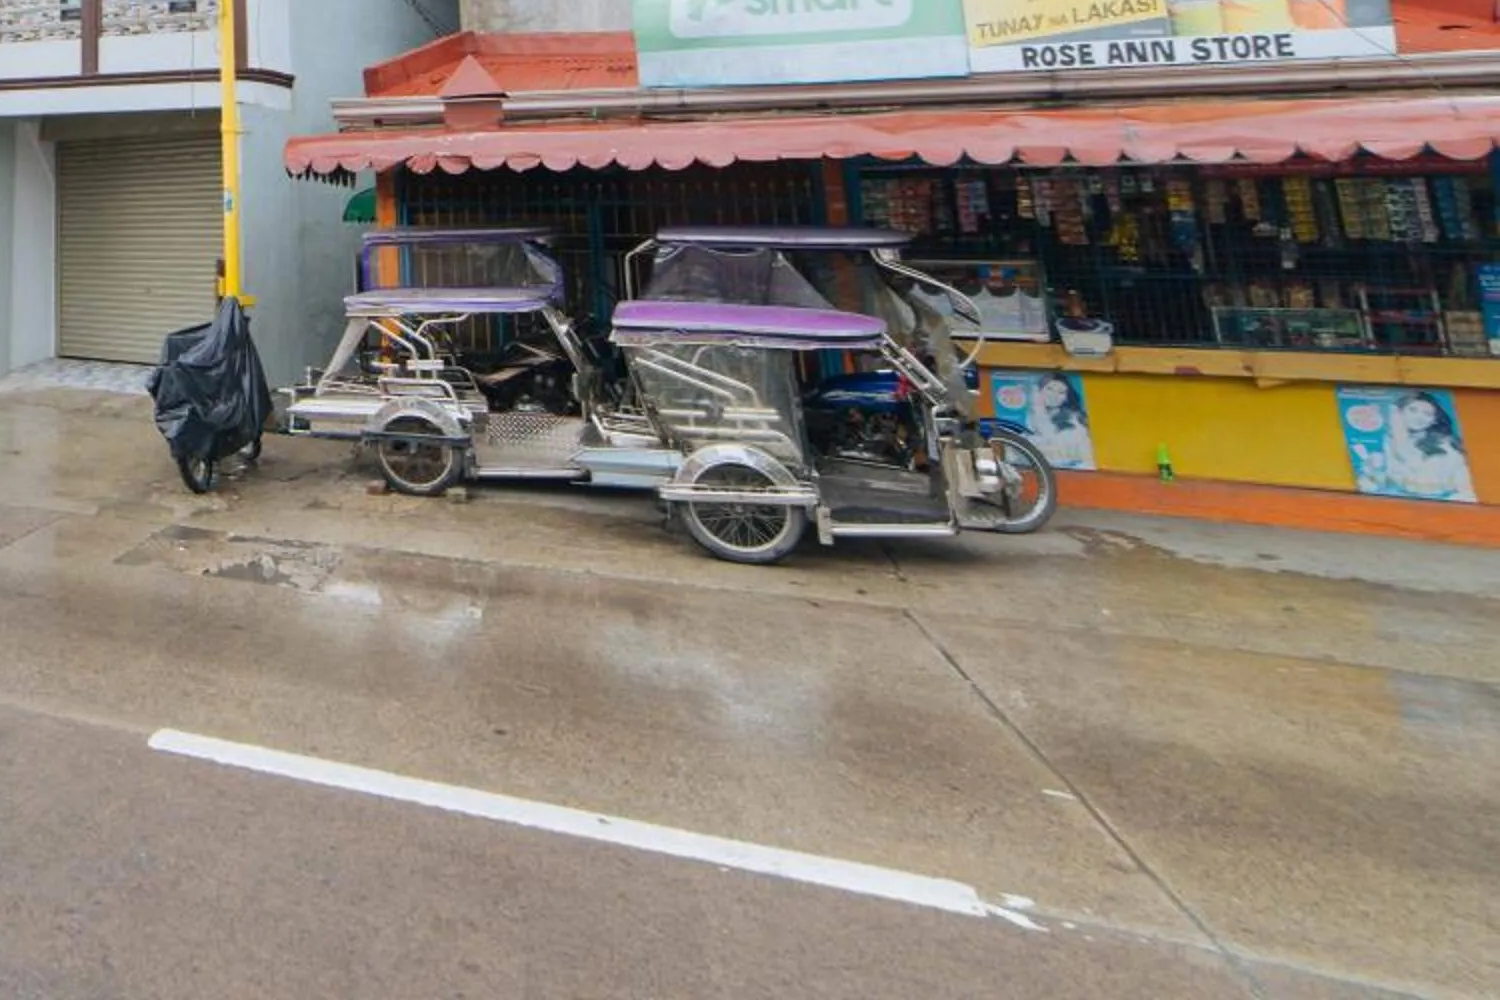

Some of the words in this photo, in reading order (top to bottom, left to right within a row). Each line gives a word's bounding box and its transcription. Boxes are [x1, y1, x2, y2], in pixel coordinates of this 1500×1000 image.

[976, 13, 1043, 40] TUNAY
[1021, 43, 1096, 68] ROSE
[1107, 40, 1176, 65] ANN
[1191, 33, 1296, 61] STORE
